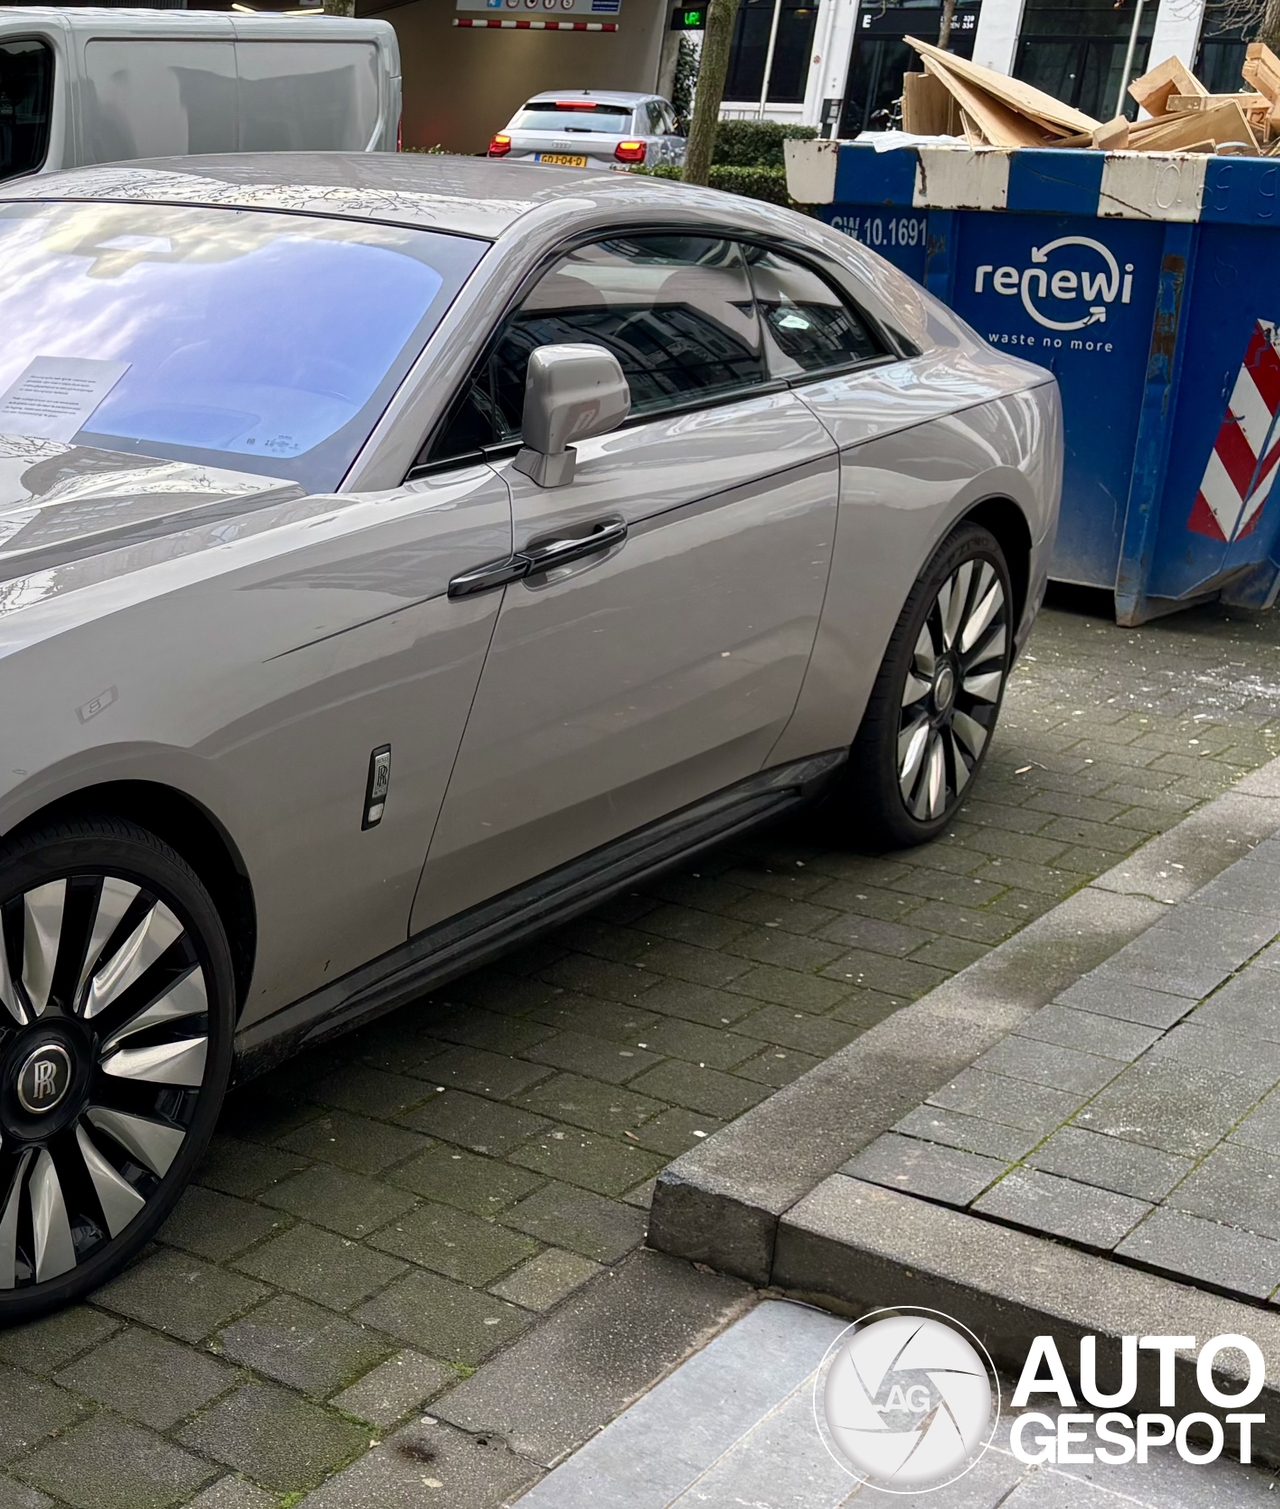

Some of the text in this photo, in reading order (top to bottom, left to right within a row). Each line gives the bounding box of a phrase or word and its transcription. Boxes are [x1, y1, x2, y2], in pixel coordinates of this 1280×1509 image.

[862, 15, 872, 28] E
[541, 155, 582, 166] GDJ-04-D
[974, 262, 1135, 304] renewi
[988, 333, 1114, 353] waste no more
